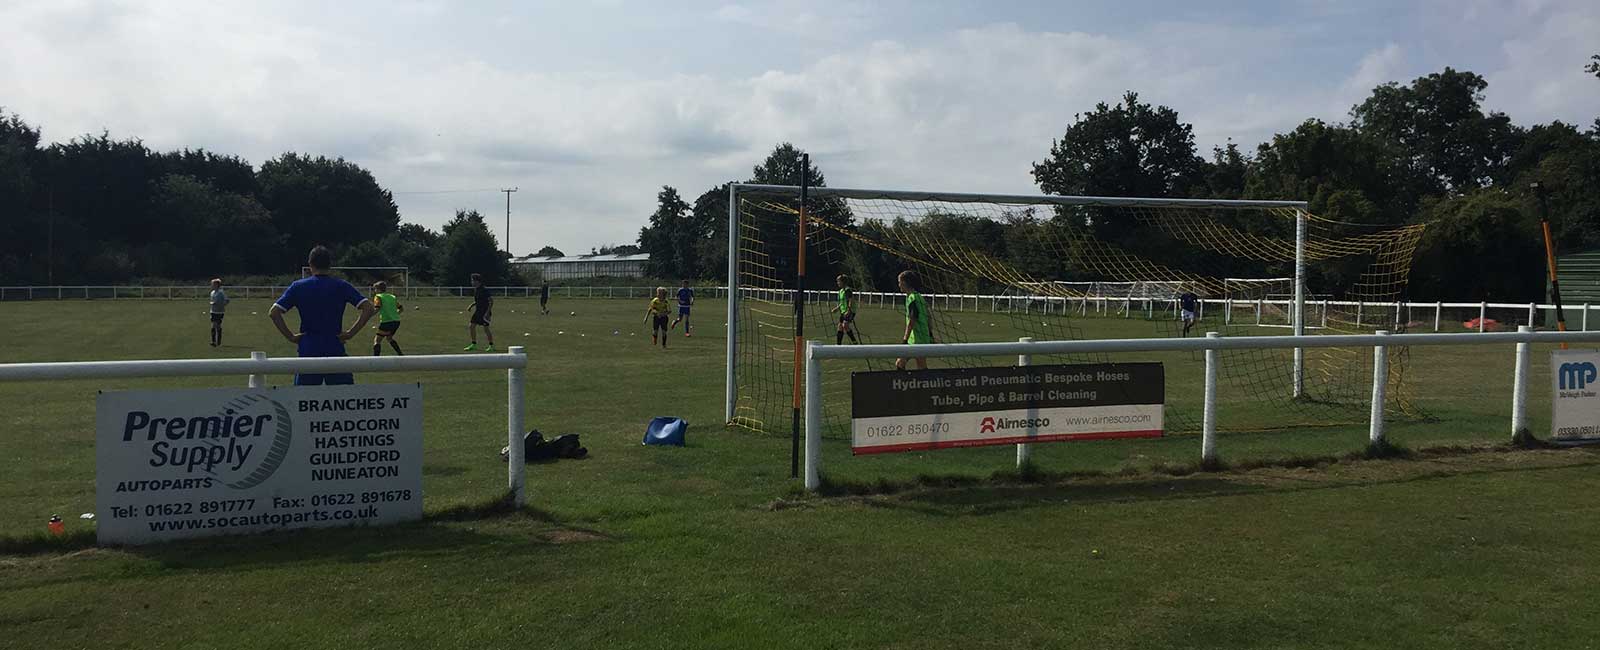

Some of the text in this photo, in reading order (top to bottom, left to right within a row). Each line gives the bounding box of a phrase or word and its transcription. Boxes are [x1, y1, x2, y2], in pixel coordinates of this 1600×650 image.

[892, 371, 1130, 391] Hydraulic and Pneumatic Bespoke Hoses
[298, 397, 410, 412] BRANCHES AT
[931, 389, 1097, 406] Tube, Pipe & Barrel Cleaning
[123, 408, 272, 441] Premier
[309, 418, 400, 433] HEADCORN
[996, 417, 1050, 430] Airnesco
[1065, 414, 1151, 426] www.airnesco.com
[867, 422, 950, 437] 01622 850470
[315, 434, 395, 449] HASTINGS
[149, 437, 253, 473] Supply
[309, 450, 400, 465] GUILDFORD
[311, 465, 399, 481] NUNEATON
[116, 476, 214, 492] AUTOPARTS
[110, 490, 412, 518] Tel: 01622 891777 Fax: 01622 891678
[149, 505, 378, 532] www.socautoparts.co.uk
